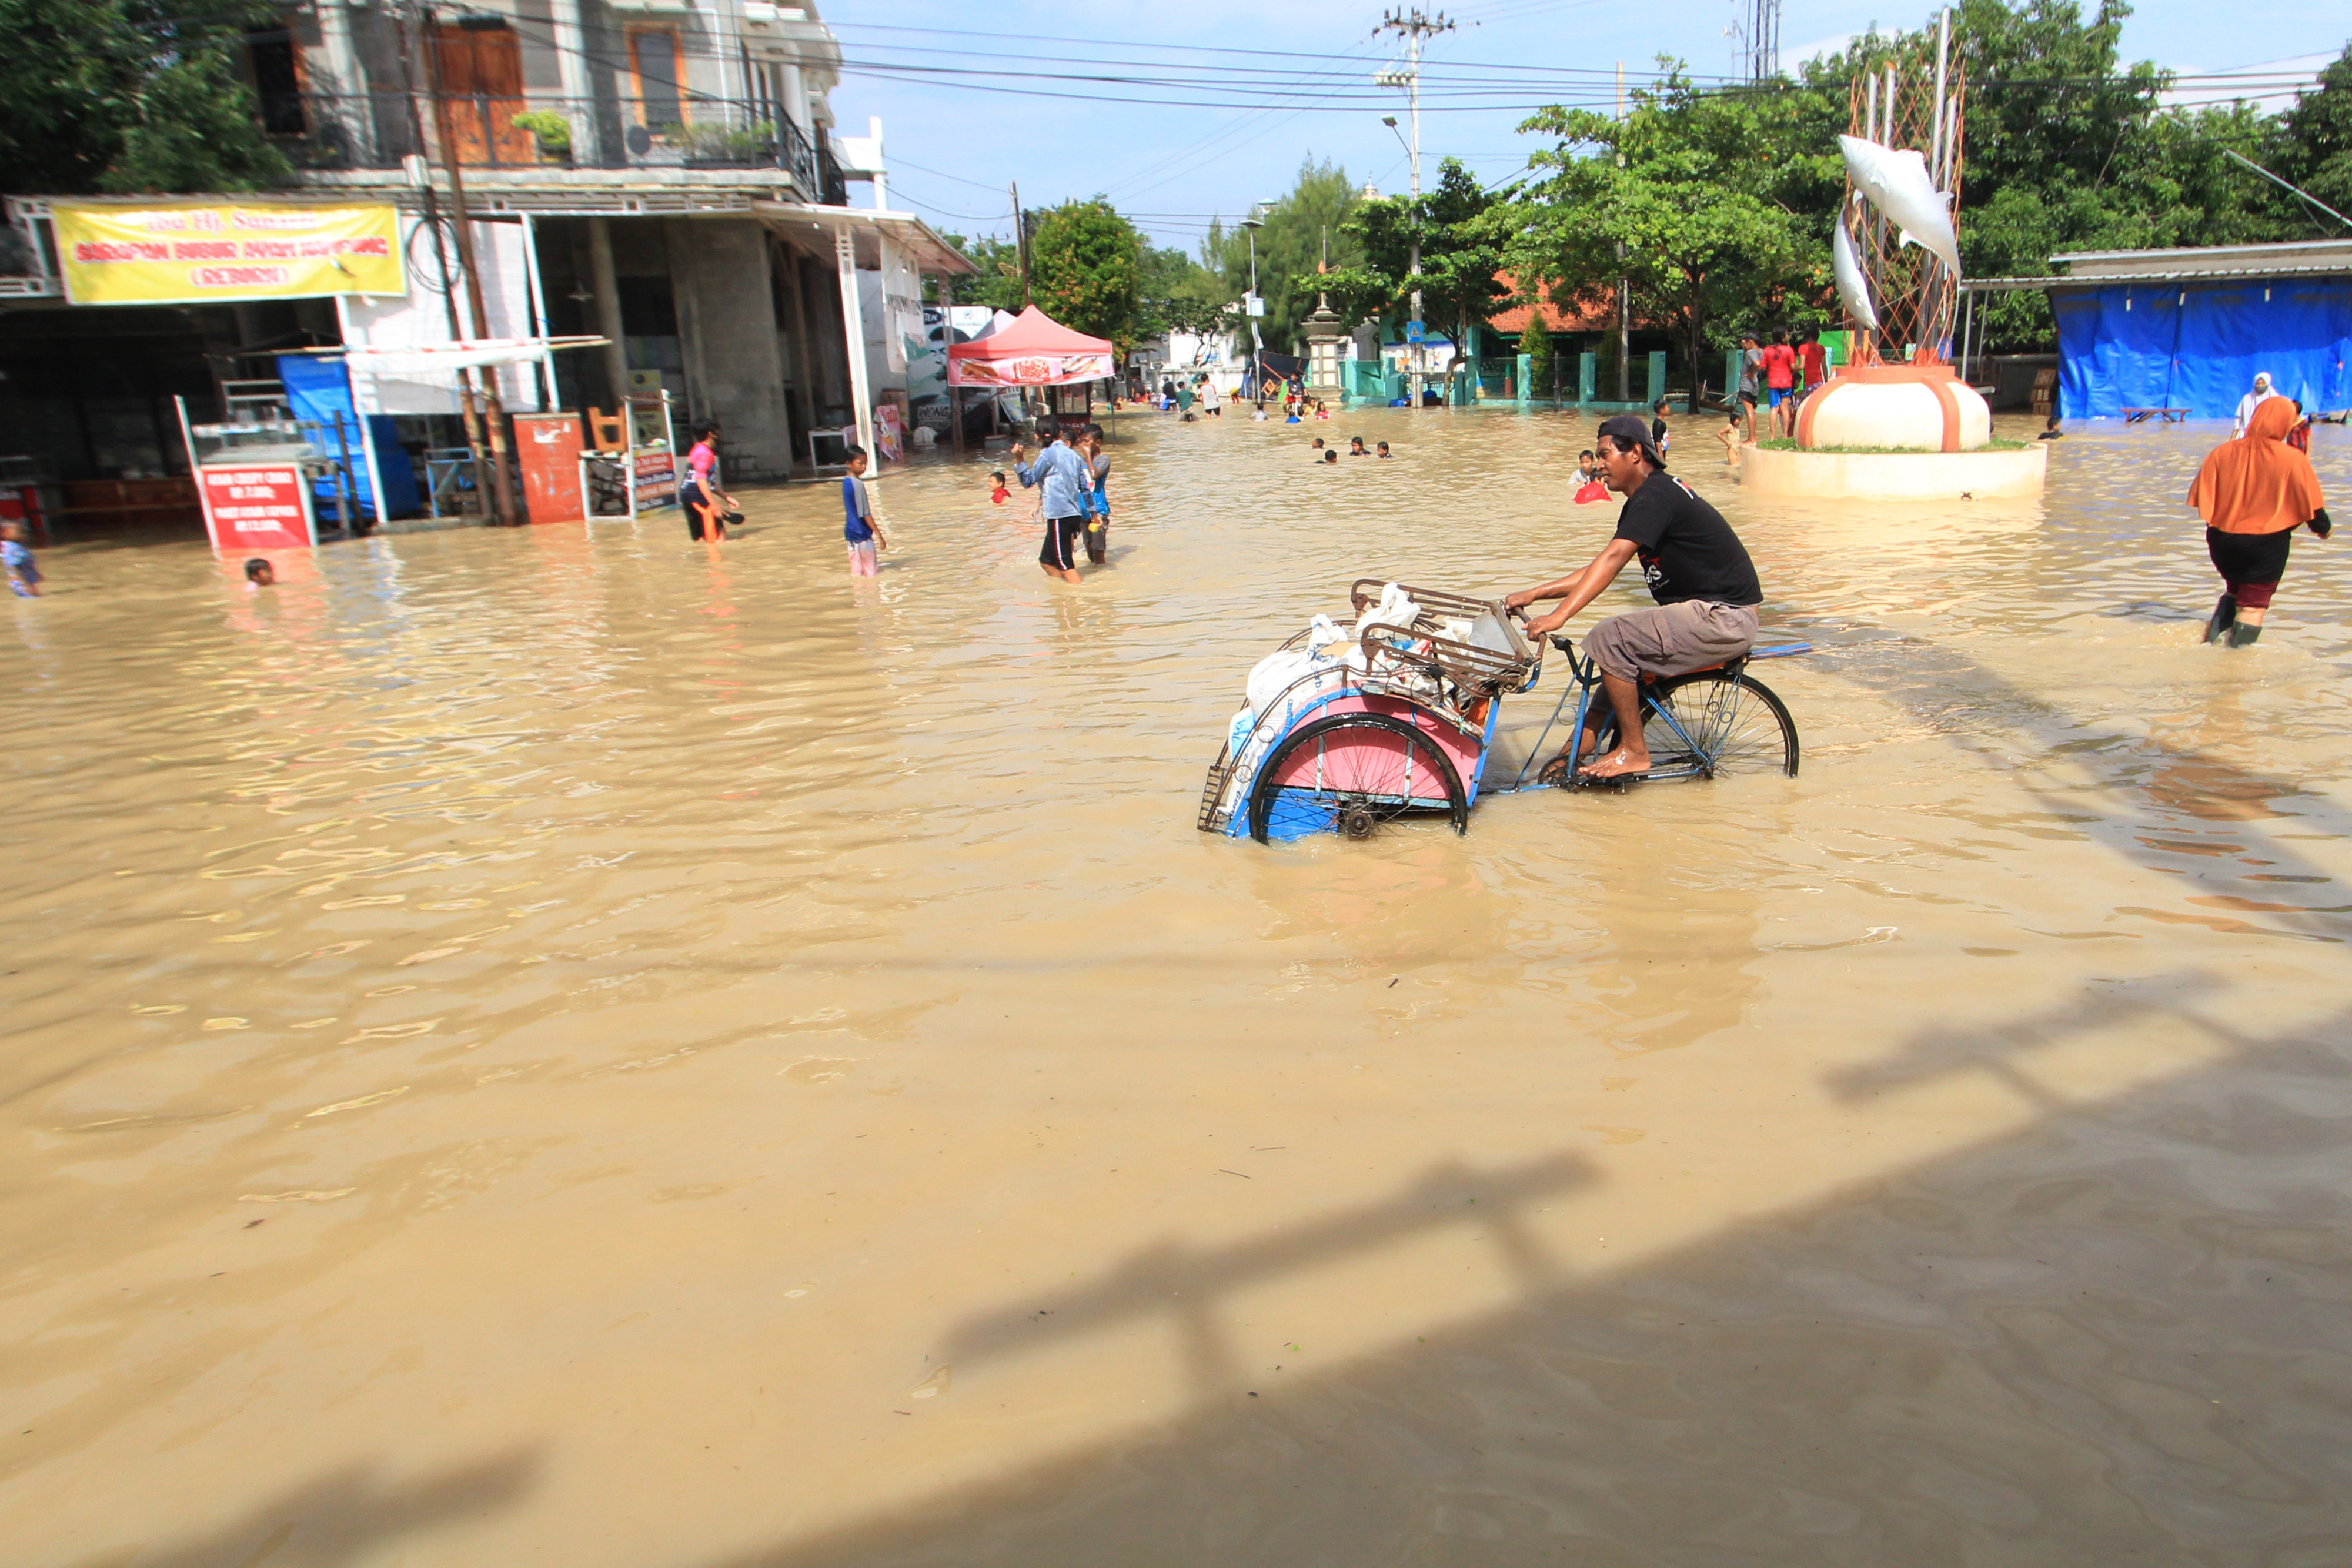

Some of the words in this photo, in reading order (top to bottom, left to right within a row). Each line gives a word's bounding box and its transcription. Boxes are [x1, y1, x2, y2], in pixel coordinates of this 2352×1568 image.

[191, 210, 227, 235] Hj.
[175, 242, 237, 259] BUBUR
[917, 406, 951, 419] WONG
